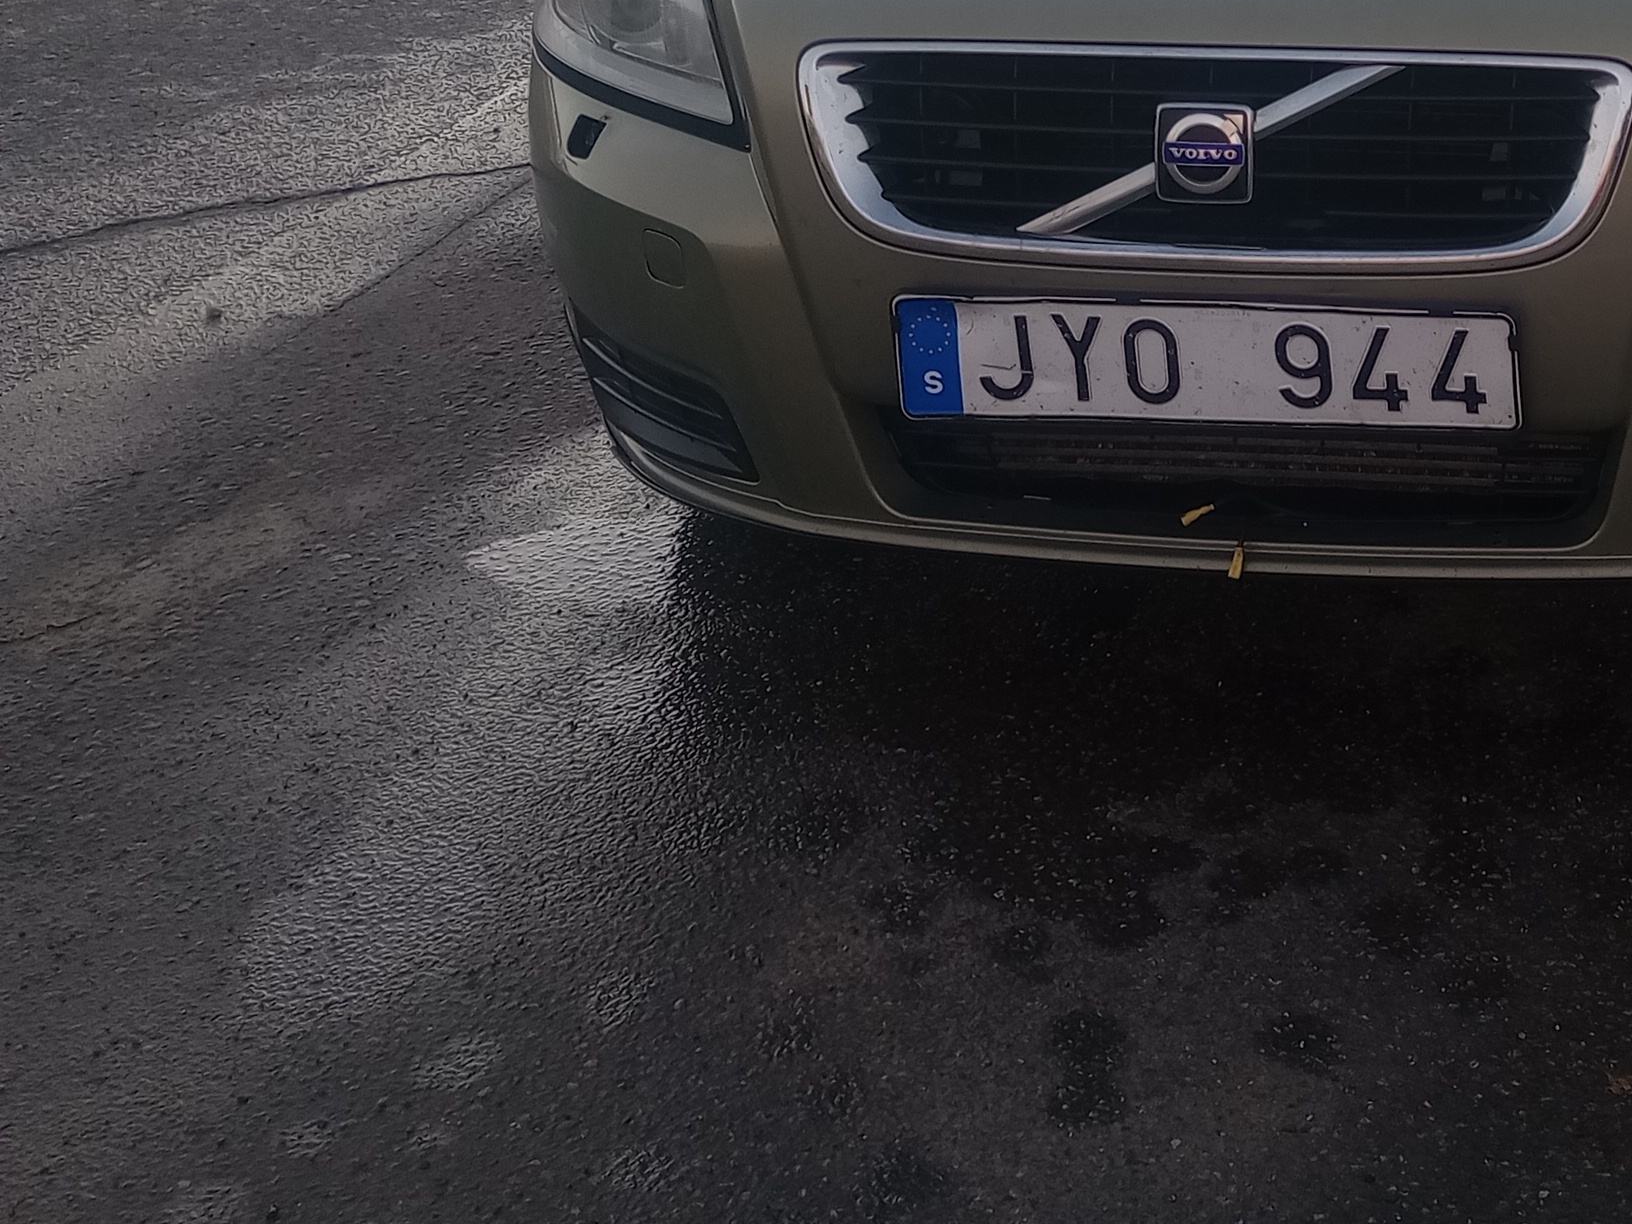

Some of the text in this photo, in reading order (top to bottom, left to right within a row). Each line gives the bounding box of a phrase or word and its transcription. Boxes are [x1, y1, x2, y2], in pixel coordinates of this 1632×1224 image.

[1168, 147, 1238, 160] VOLVO
[979, 313, 1488, 415] JYO 944
[924, 370, 944, 395] S
